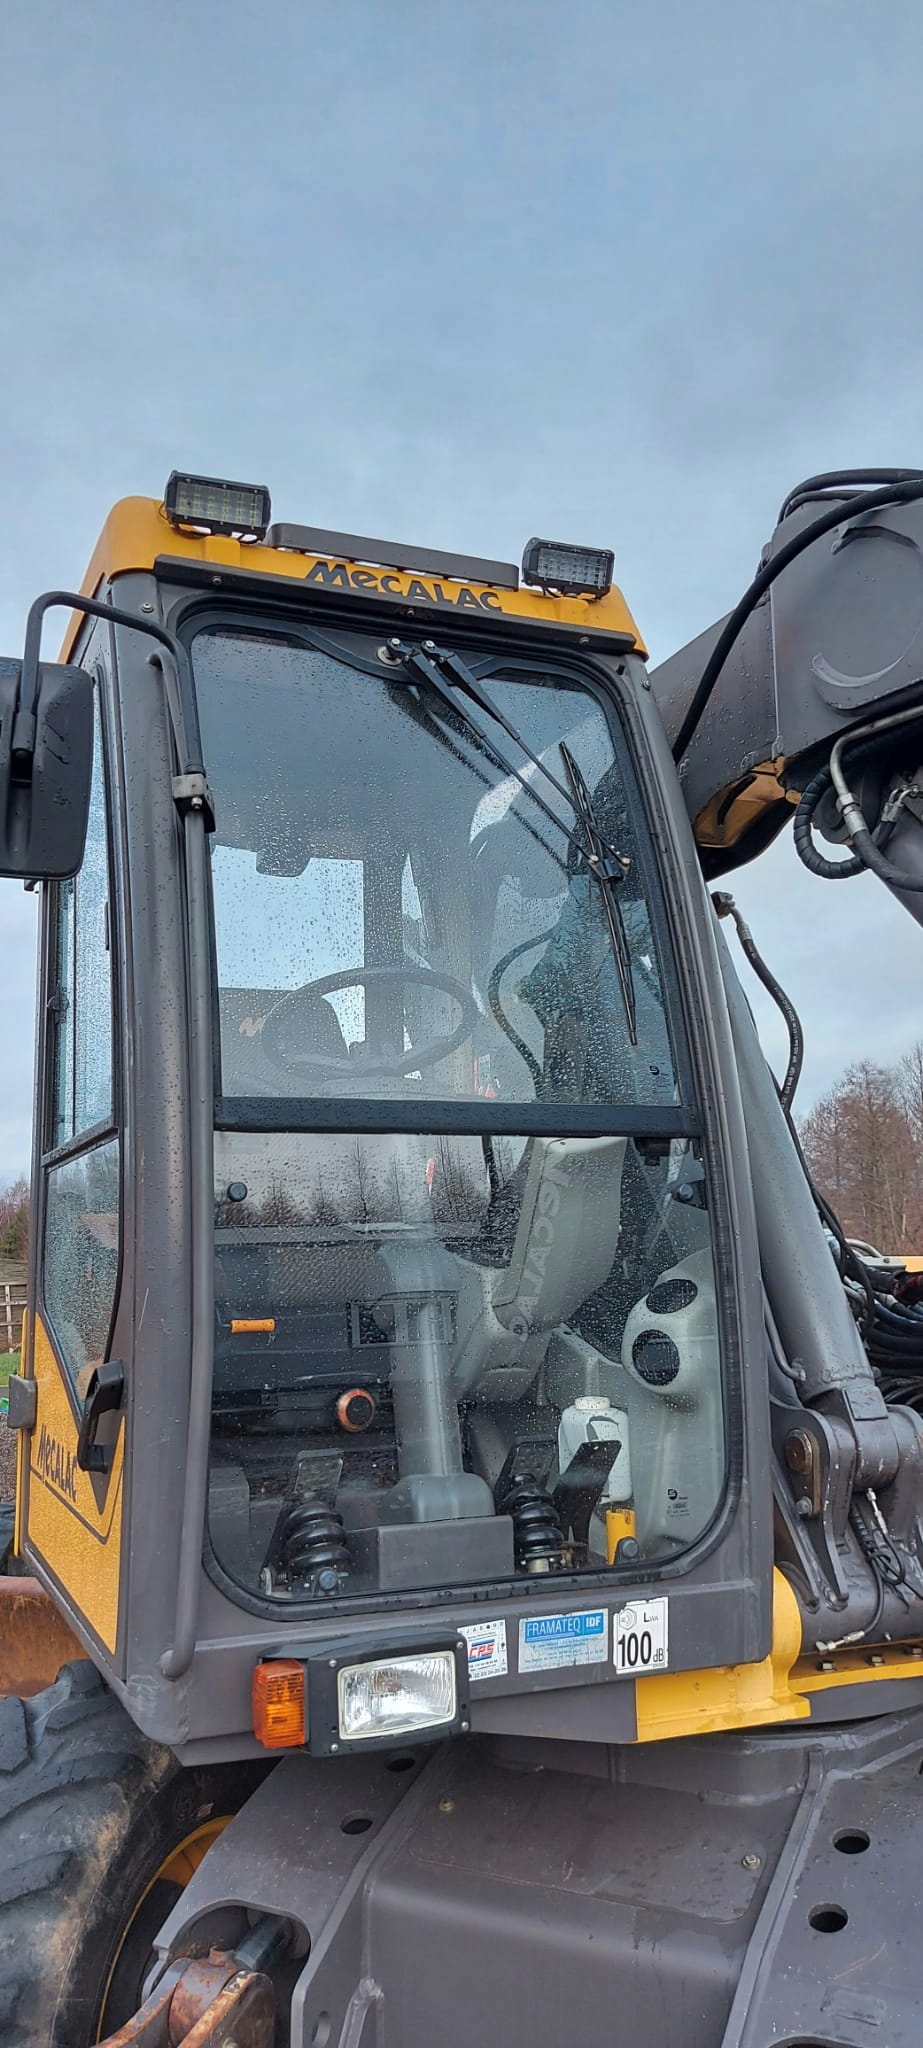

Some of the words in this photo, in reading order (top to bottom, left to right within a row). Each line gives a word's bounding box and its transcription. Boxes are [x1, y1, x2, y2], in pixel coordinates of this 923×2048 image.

[526, 1616, 582, 1637] FRAMATEQ
[585, 1615, 602, 1628] IDF
[468, 1642, 495, 1659] CPS
[617, 1630, 652, 1667] 100
[652, 1647, 665, 1663] dB
